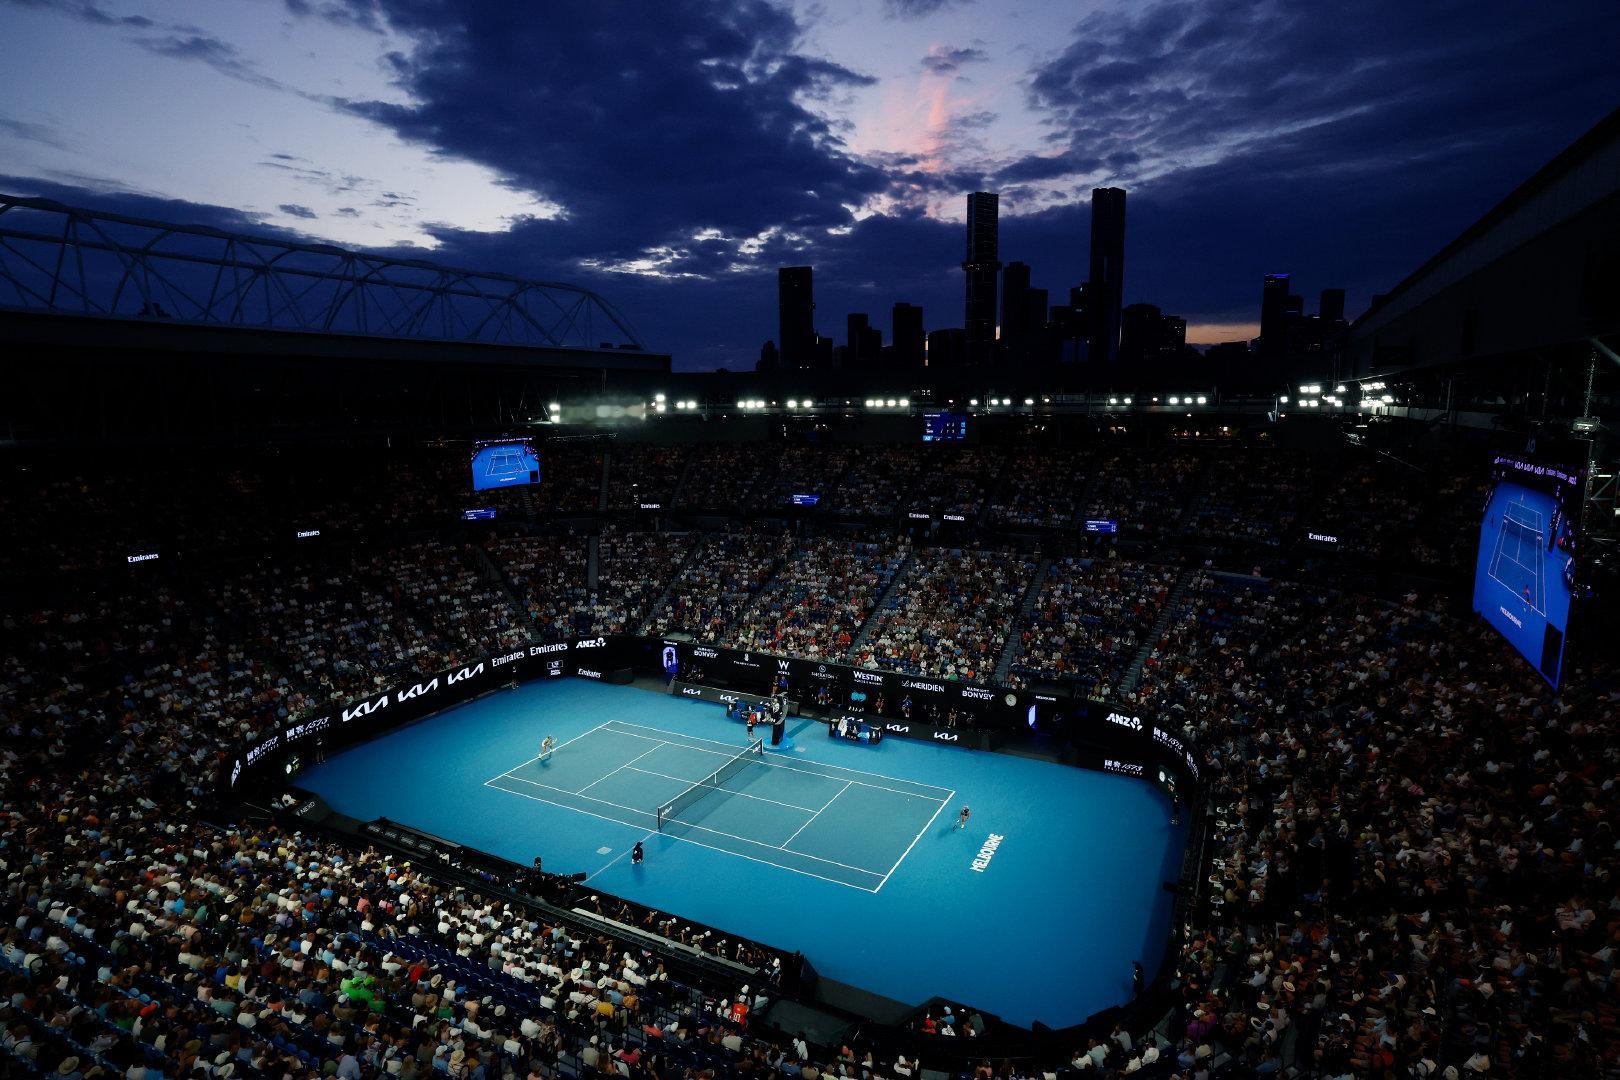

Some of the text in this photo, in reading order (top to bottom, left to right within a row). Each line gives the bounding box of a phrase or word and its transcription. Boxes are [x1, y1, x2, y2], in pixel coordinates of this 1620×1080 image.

[297, 529, 320, 538] Emirates
[1308, 532, 1338, 543] Emirates
[127, 553, 159, 563] Emirates
[530, 642, 568, 656] Emirates
[575, 639, 596, 649] ANZ
[491, 649, 525, 667] Emirates
[778, 659, 790, 670] W
[447, 662, 484, 685] KIA
[578, 668, 602, 679] Emirates
[853, 670, 882, 683] WESTIN
[397, 678, 439, 703] KIA
[682, 687, 701, 696] KIA
[962, 690, 994, 701] BONVOY
[342, 695, 389, 722] KIA
[1106, 712, 1131, 727] ANZ
[886, 722, 909, 733] KIA
[933, 731, 958, 742] KIA
[969, 833, 1004, 873] MELBOURNE
